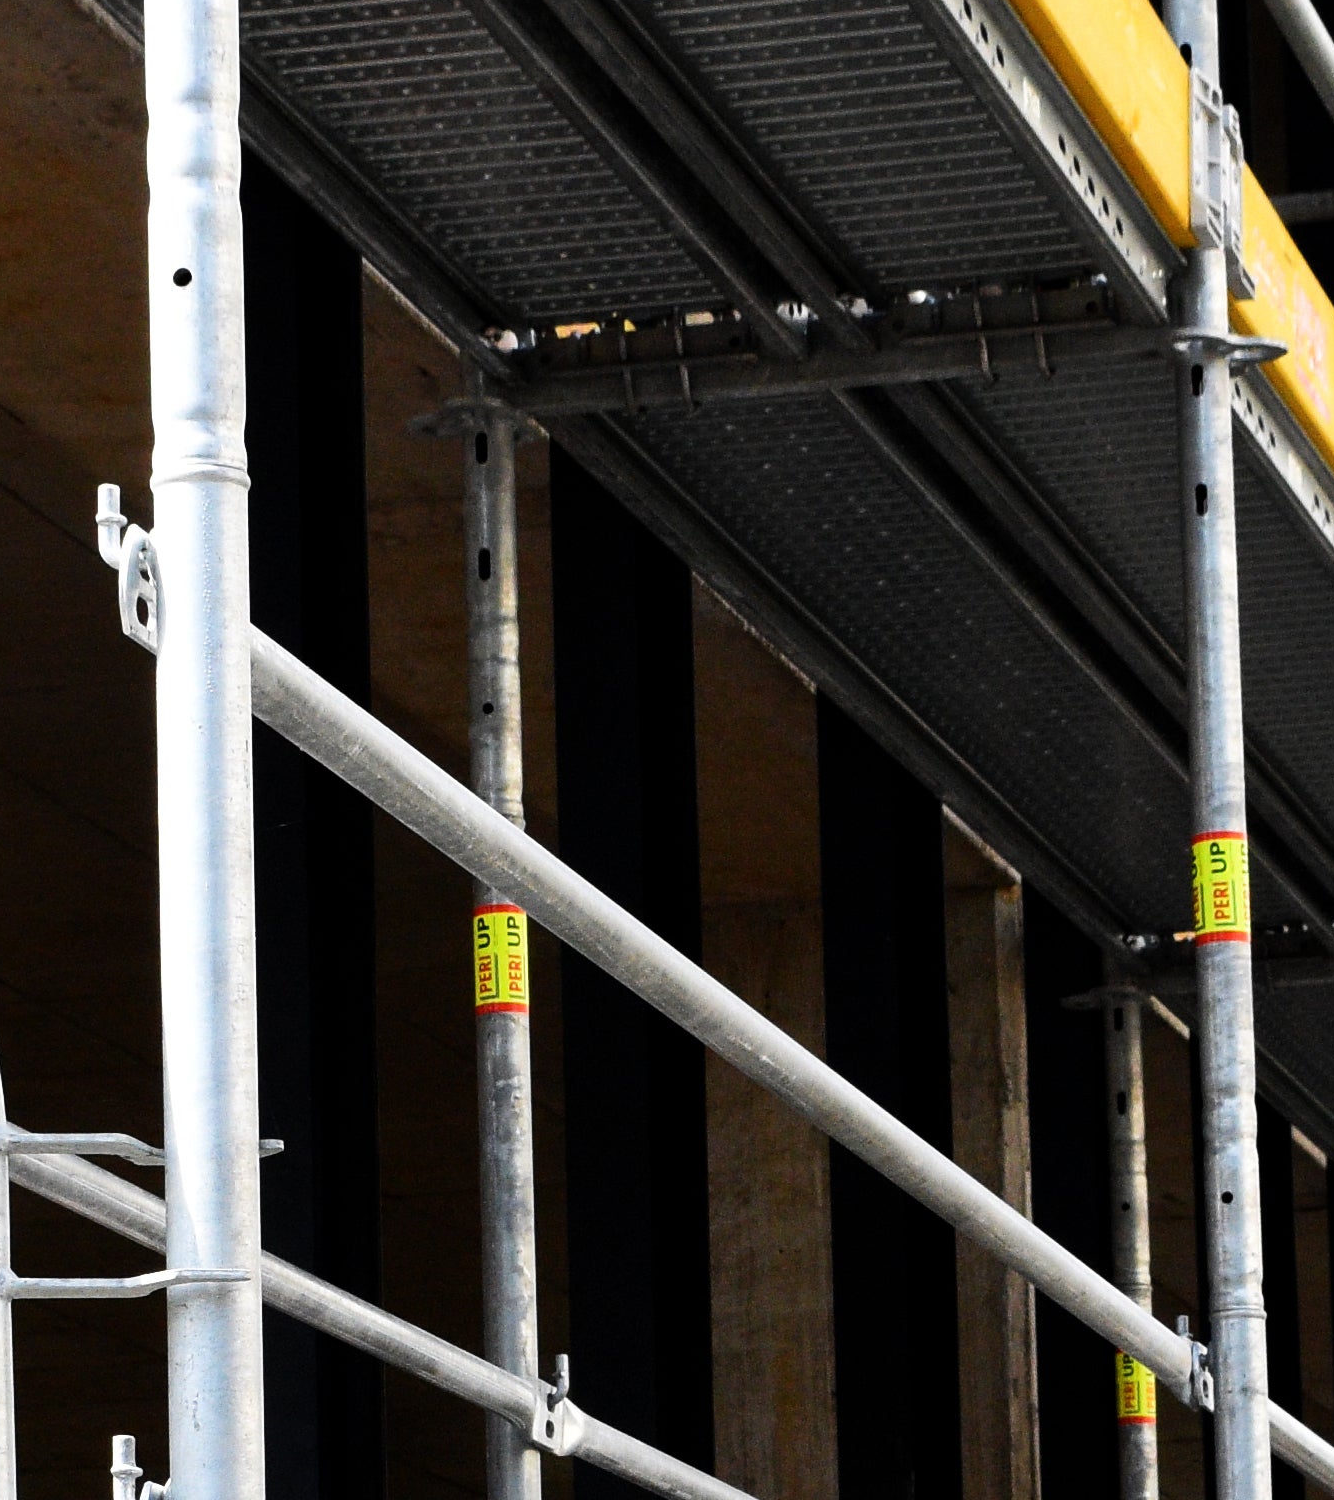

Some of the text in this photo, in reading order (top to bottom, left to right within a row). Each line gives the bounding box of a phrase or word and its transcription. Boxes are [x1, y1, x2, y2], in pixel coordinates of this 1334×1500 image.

[1209, 842, 1231, 921] PERI UP
[477, 917, 494, 994] PERI UP
[507, 915, 523, 992] PERI UP
